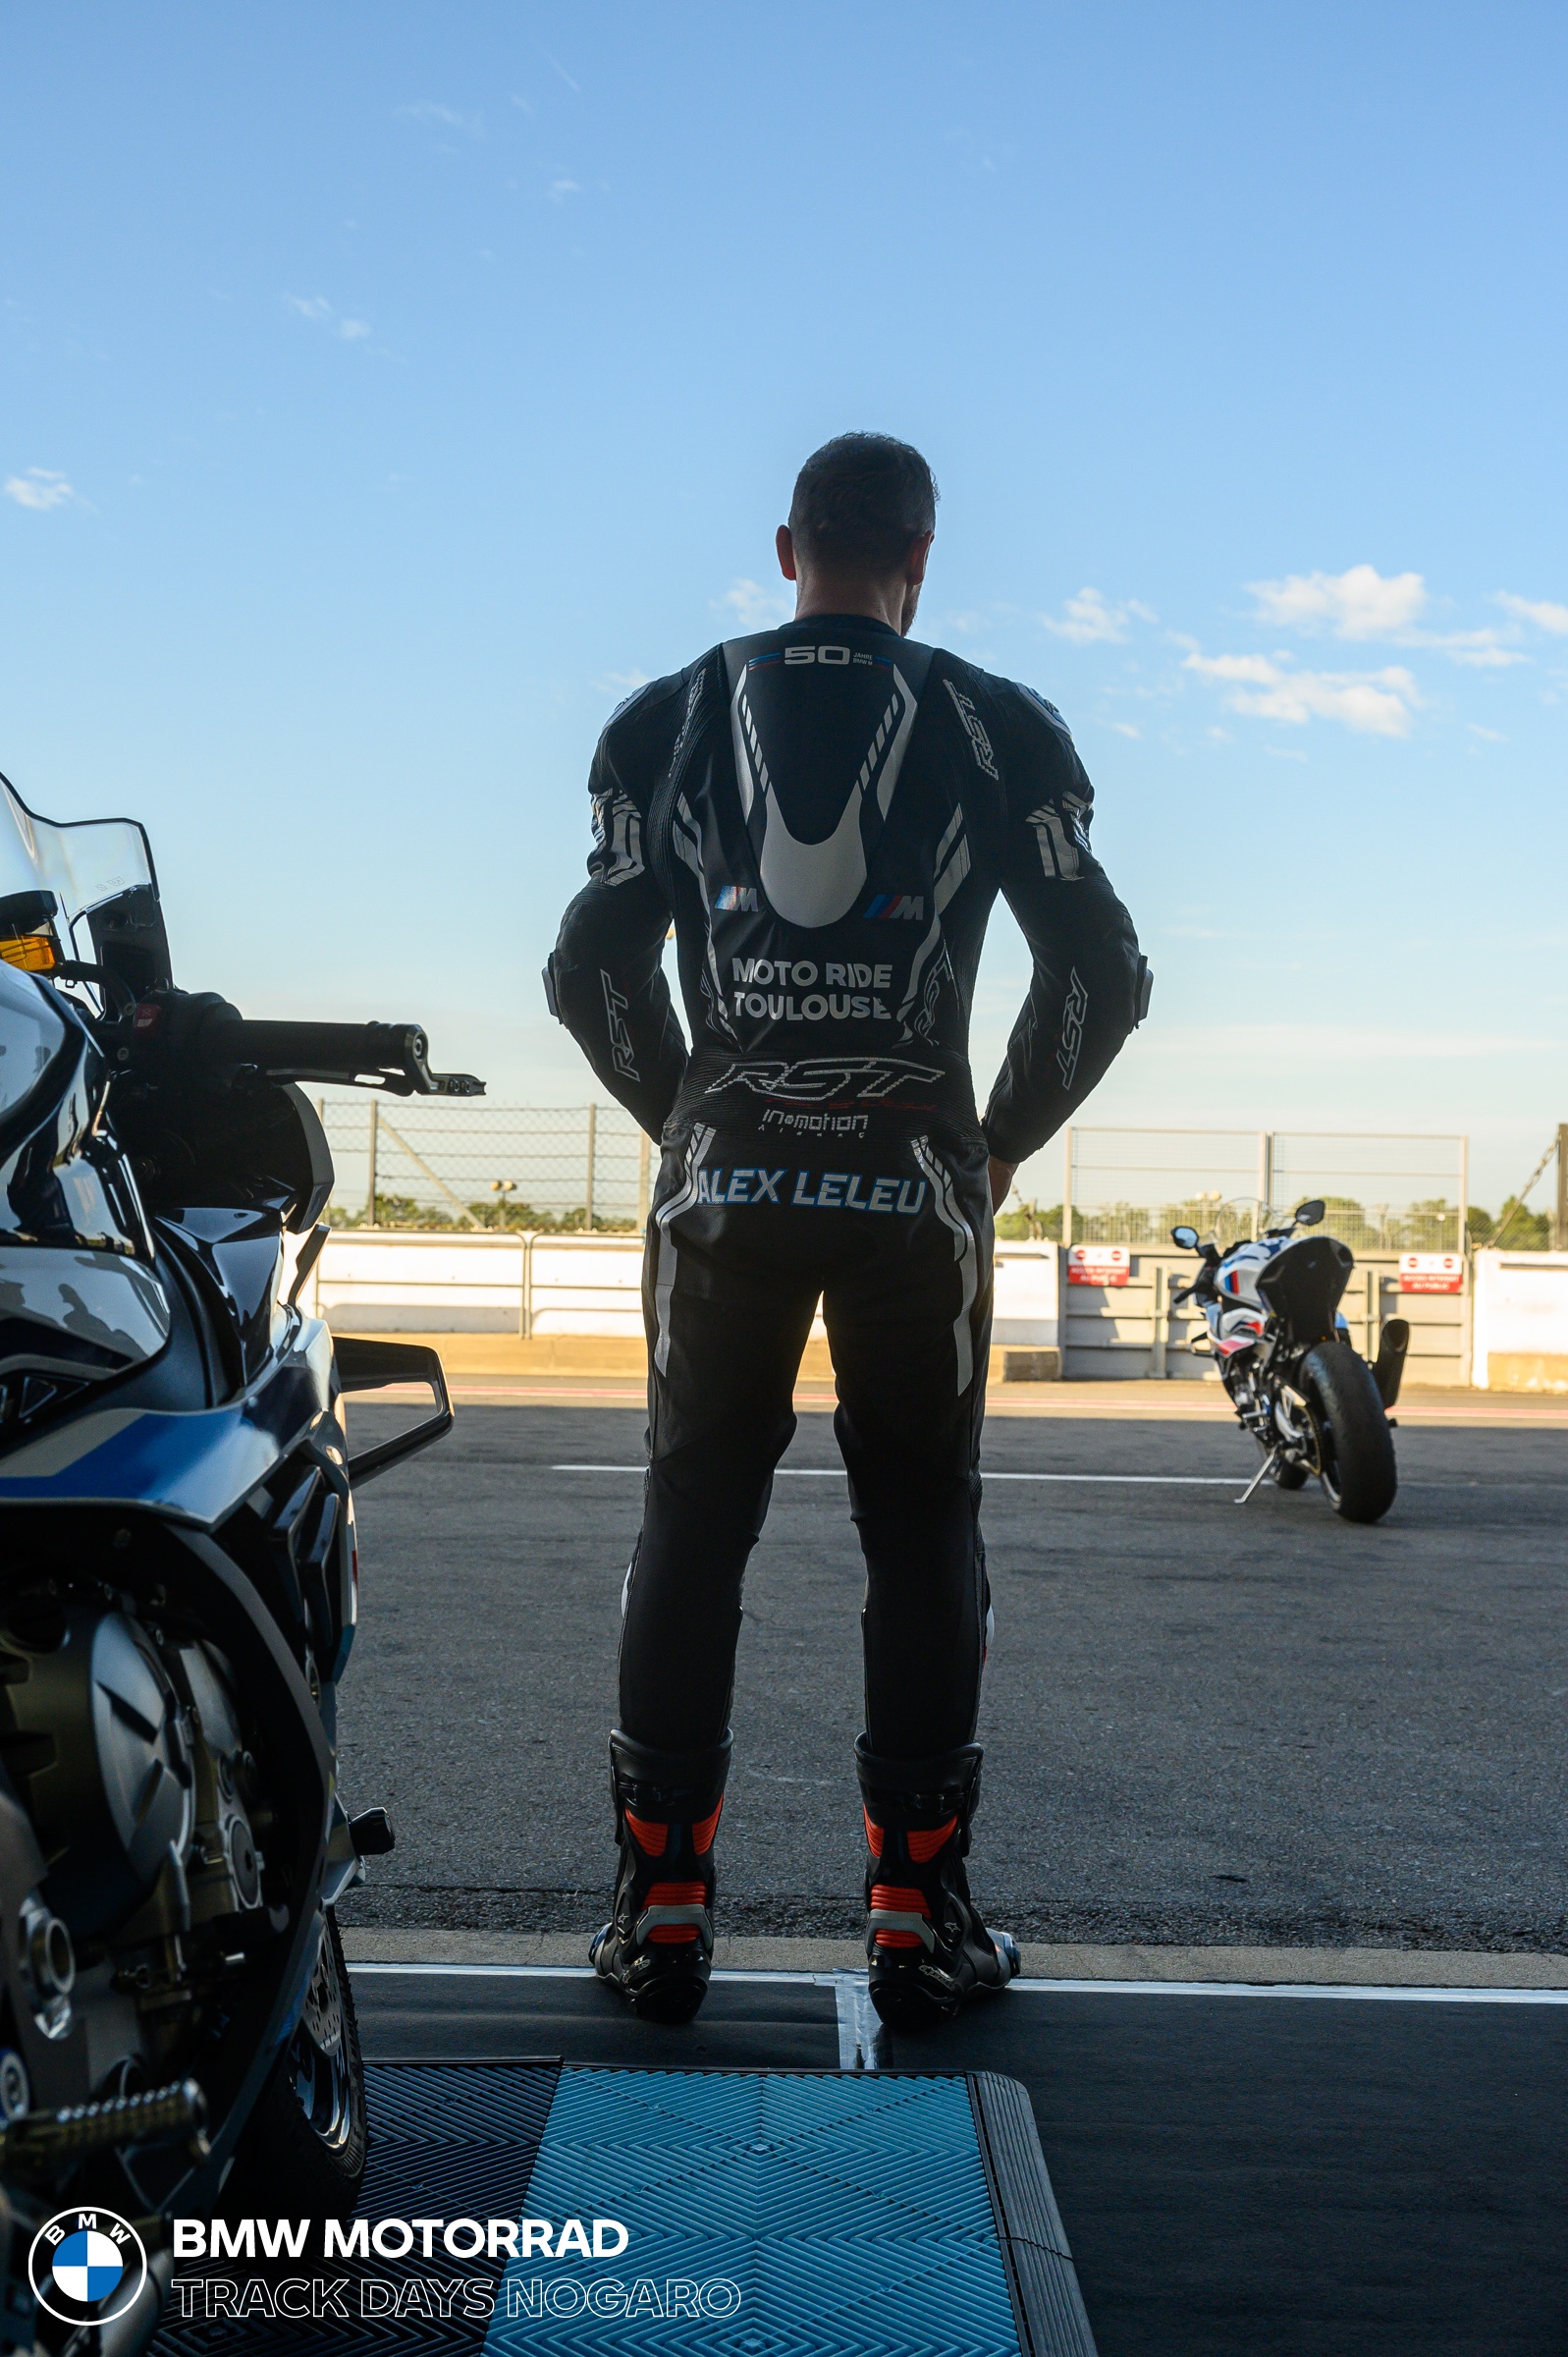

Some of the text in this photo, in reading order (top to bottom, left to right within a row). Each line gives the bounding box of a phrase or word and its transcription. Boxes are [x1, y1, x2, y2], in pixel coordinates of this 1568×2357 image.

[784, 645, 850, 665] 50
[889, 895, 924, 920] M
[732, 958, 892, 989] MOTO RIDE
[733, 991, 892, 1020] TOULOUSE
[600, 968, 640, 1082] RST
[1056, 965, 1088, 1090] RST
[704, 1057, 946, 1101] RST
[697, 1168, 927, 1215] ALEX LELEU
